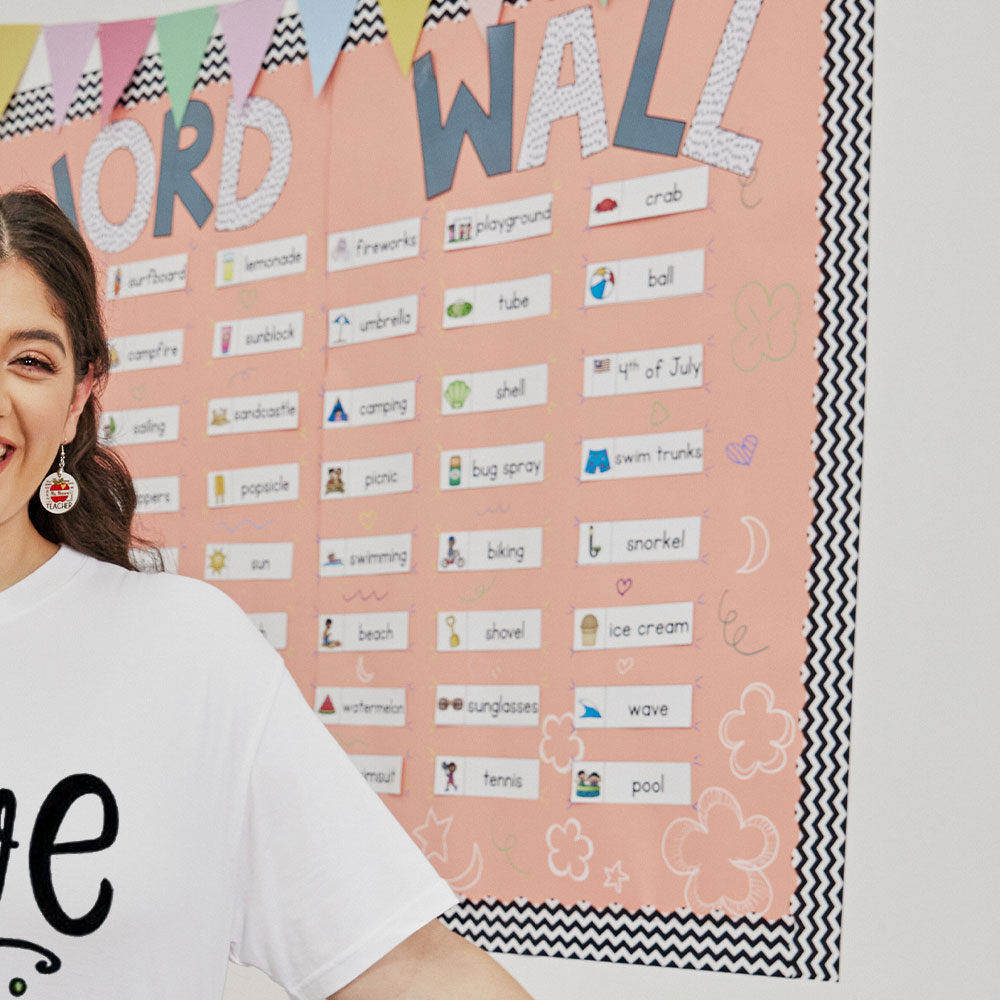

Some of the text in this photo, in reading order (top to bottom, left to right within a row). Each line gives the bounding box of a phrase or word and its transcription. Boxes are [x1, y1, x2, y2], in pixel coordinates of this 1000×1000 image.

[413, 0, 762, 201] WALL
[645, 182, 683, 207] crab
[476, 201, 552, 233] playground
[356, 231, 417, 257] fireworks
[245, 247, 302, 272] lemonade
[128, 263, 187, 289] surfboard
[648, 265, 675, 288] ball
[498, 292, 530, 311] tube
[360, 308, 411, 333] umbrella
[245, 323, 296, 346] sunblock
[128, 342, 178, 362] campfire
[645, 359, 664, 379] of
[669, 356, 702, 380] July
[496, 378, 526, 400] shell
[234, 401, 296, 421] sandcastle
[359, 397, 408, 417] camping
[133, 417, 166, 438] sailing
[614, 443, 703, 465] swim trunks
[365, 470, 399, 490] picnic
[472, 459, 541, 482] bug spray
[241, 475, 290, 500] popsicle
[626, 529, 686, 552] snorkel
[350, 549, 408, 568] swimming
[487, 541, 525, 563] biking
[250, 558, 271, 571] sun
[358, 623, 394, 642] beach
[485, 620, 526, 641] shovel
[609, 620, 690, 638] ice cream
[343, 699, 404, 715] watermelon
[468, 694, 539, 718] sunglasses
[628, 702, 669, 718] wave
[483, 768, 523, 789] tennis
[632, 774, 665, 798] pool
